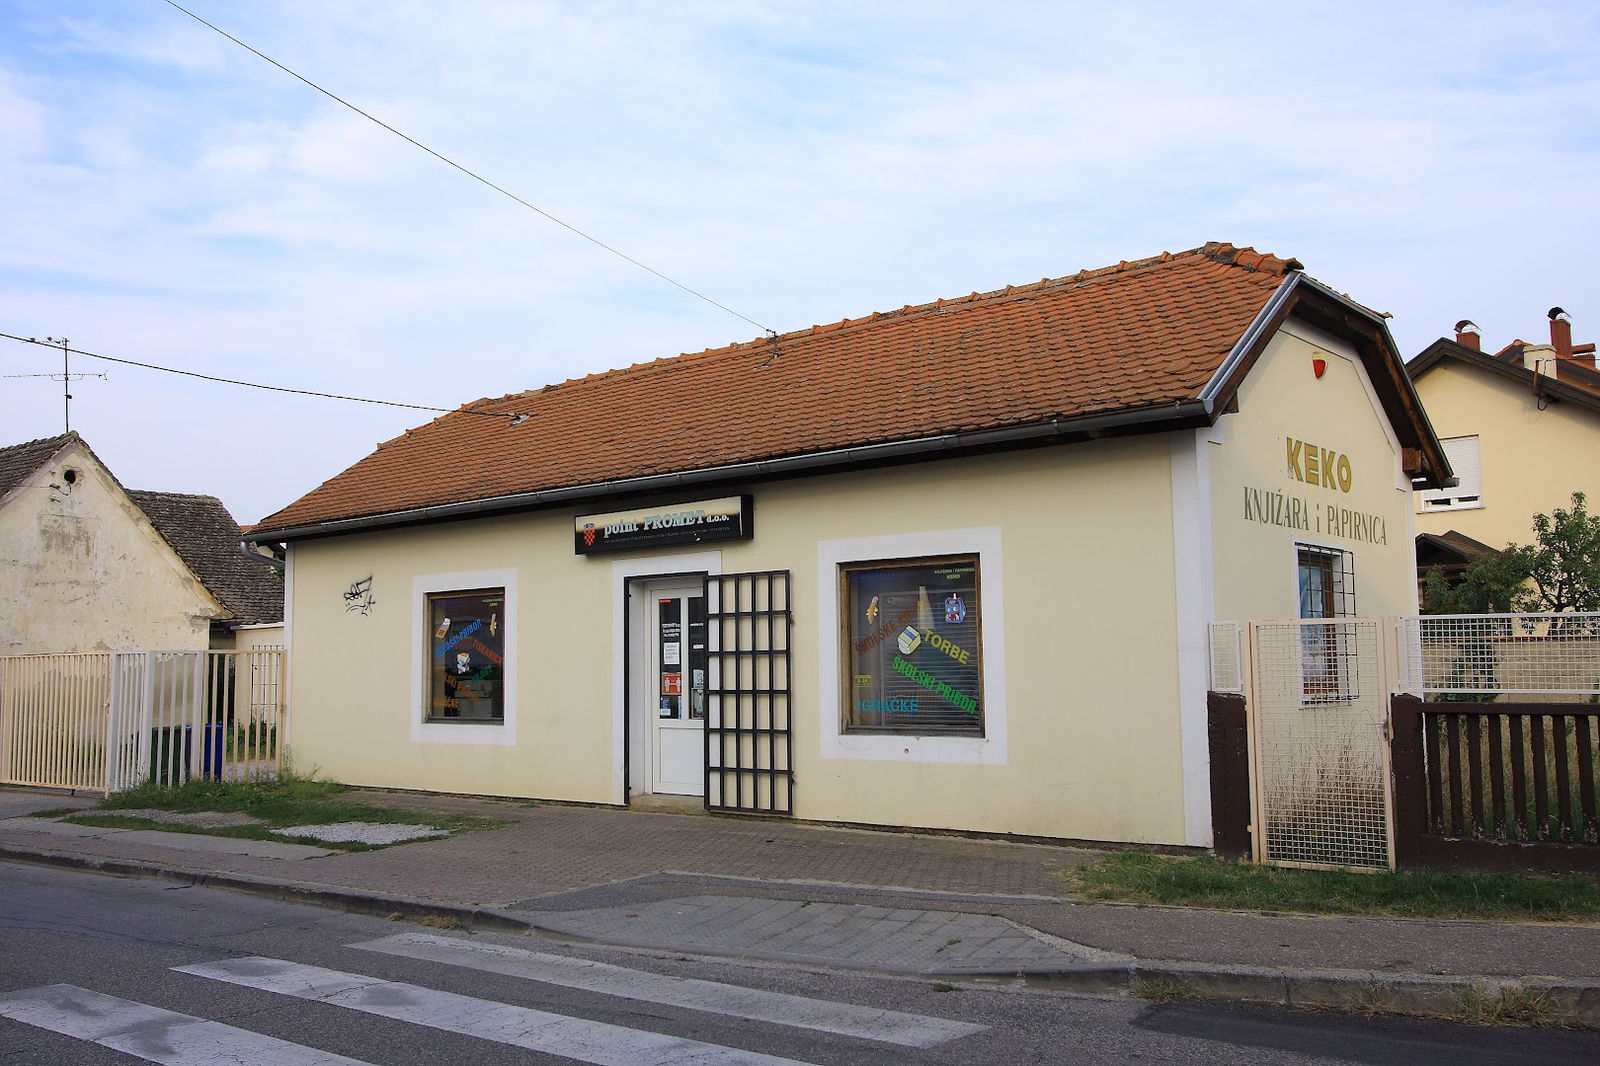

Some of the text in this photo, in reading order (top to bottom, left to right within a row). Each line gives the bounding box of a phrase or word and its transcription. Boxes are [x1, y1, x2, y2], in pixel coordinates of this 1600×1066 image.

[1286, 436, 1352, 494] KEKO
[603, 520, 640, 538] point
[643, 510, 705, 530] PROMET
[706, 513, 730, 524] d.o.o.
[1243, 486, 1310, 531] KNJIŽARA
[1327, 503, 1388, 546] PAPIRNICA
[924, 628, 971, 665] TORBE
